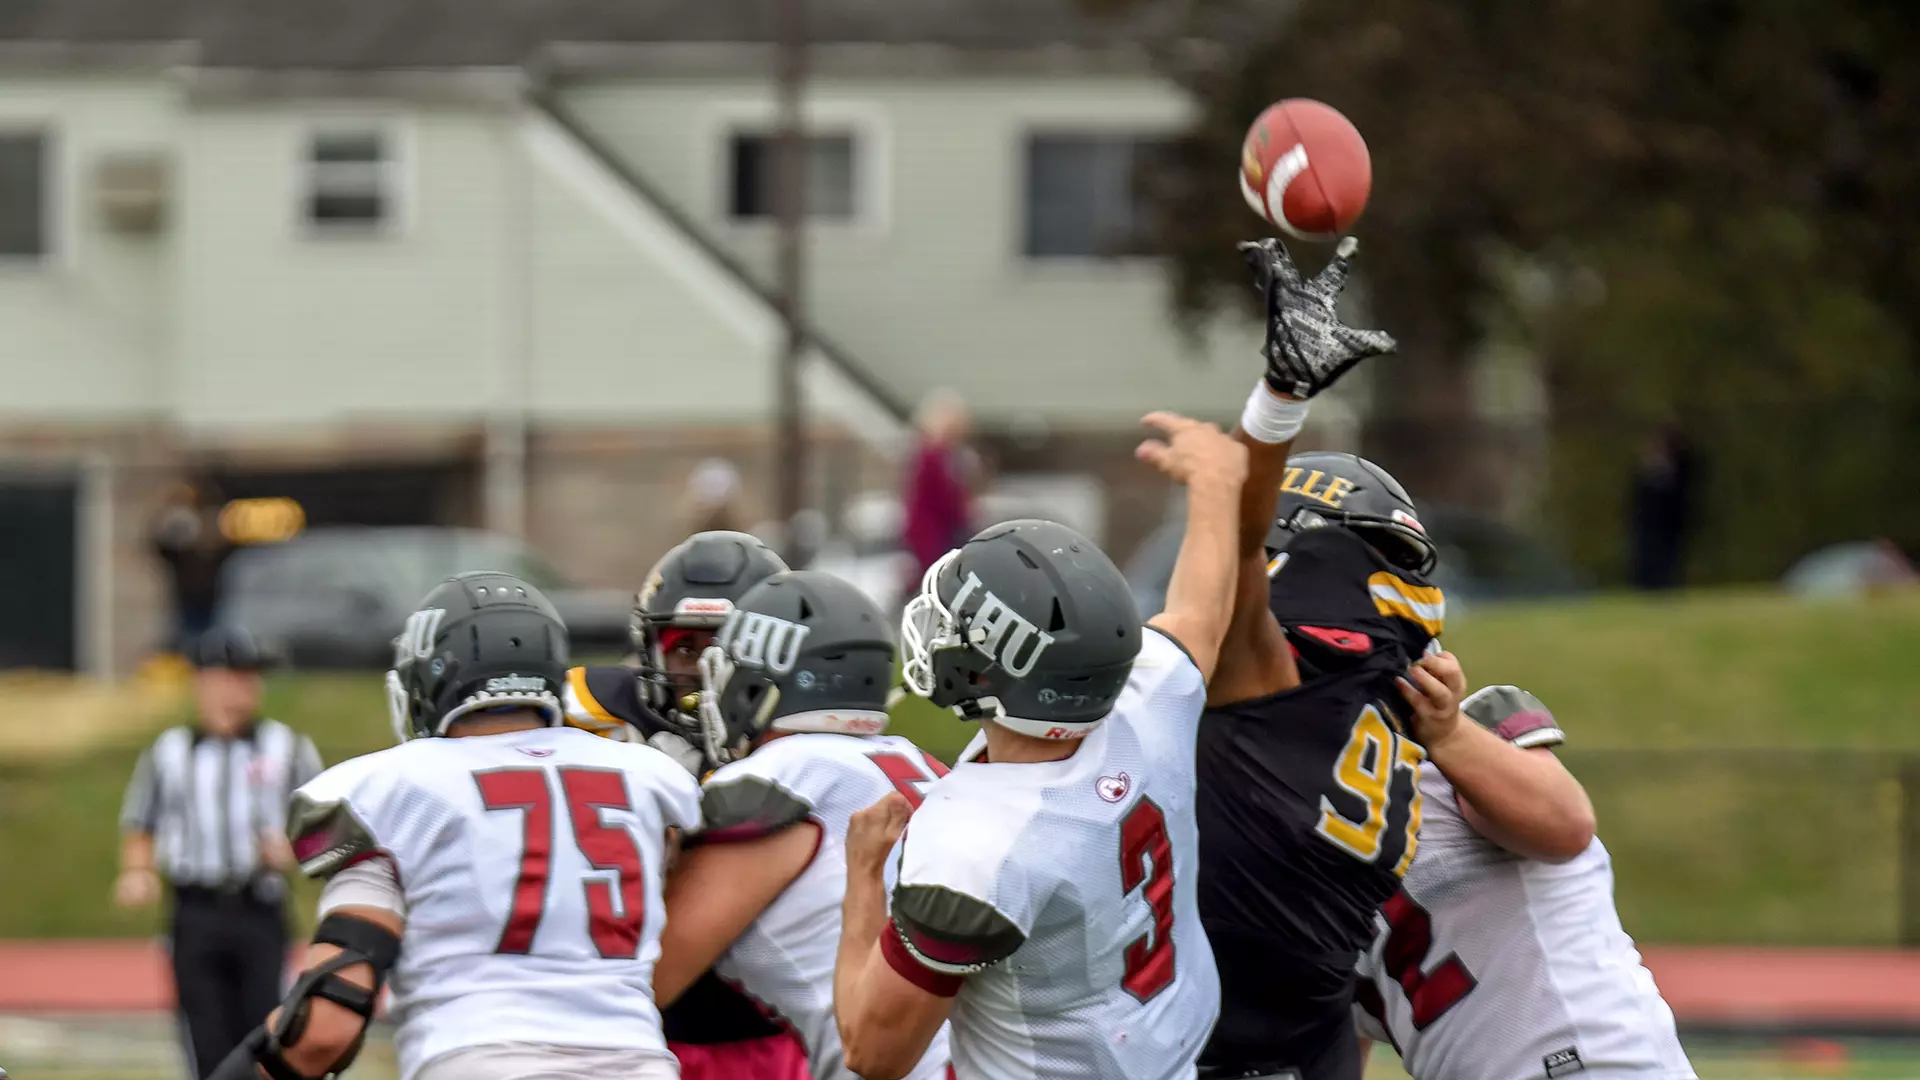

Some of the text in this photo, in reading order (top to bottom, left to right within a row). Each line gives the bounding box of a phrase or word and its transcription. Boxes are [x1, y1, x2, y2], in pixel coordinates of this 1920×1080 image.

[1280, 466, 1354, 509] LLE
[470, 765, 650, 960] 75
[1315, 703, 1428, 878] 97
[1119, 793, 1176, 1004] 3
[1547, 1049, 1577, 1067] 2XL
